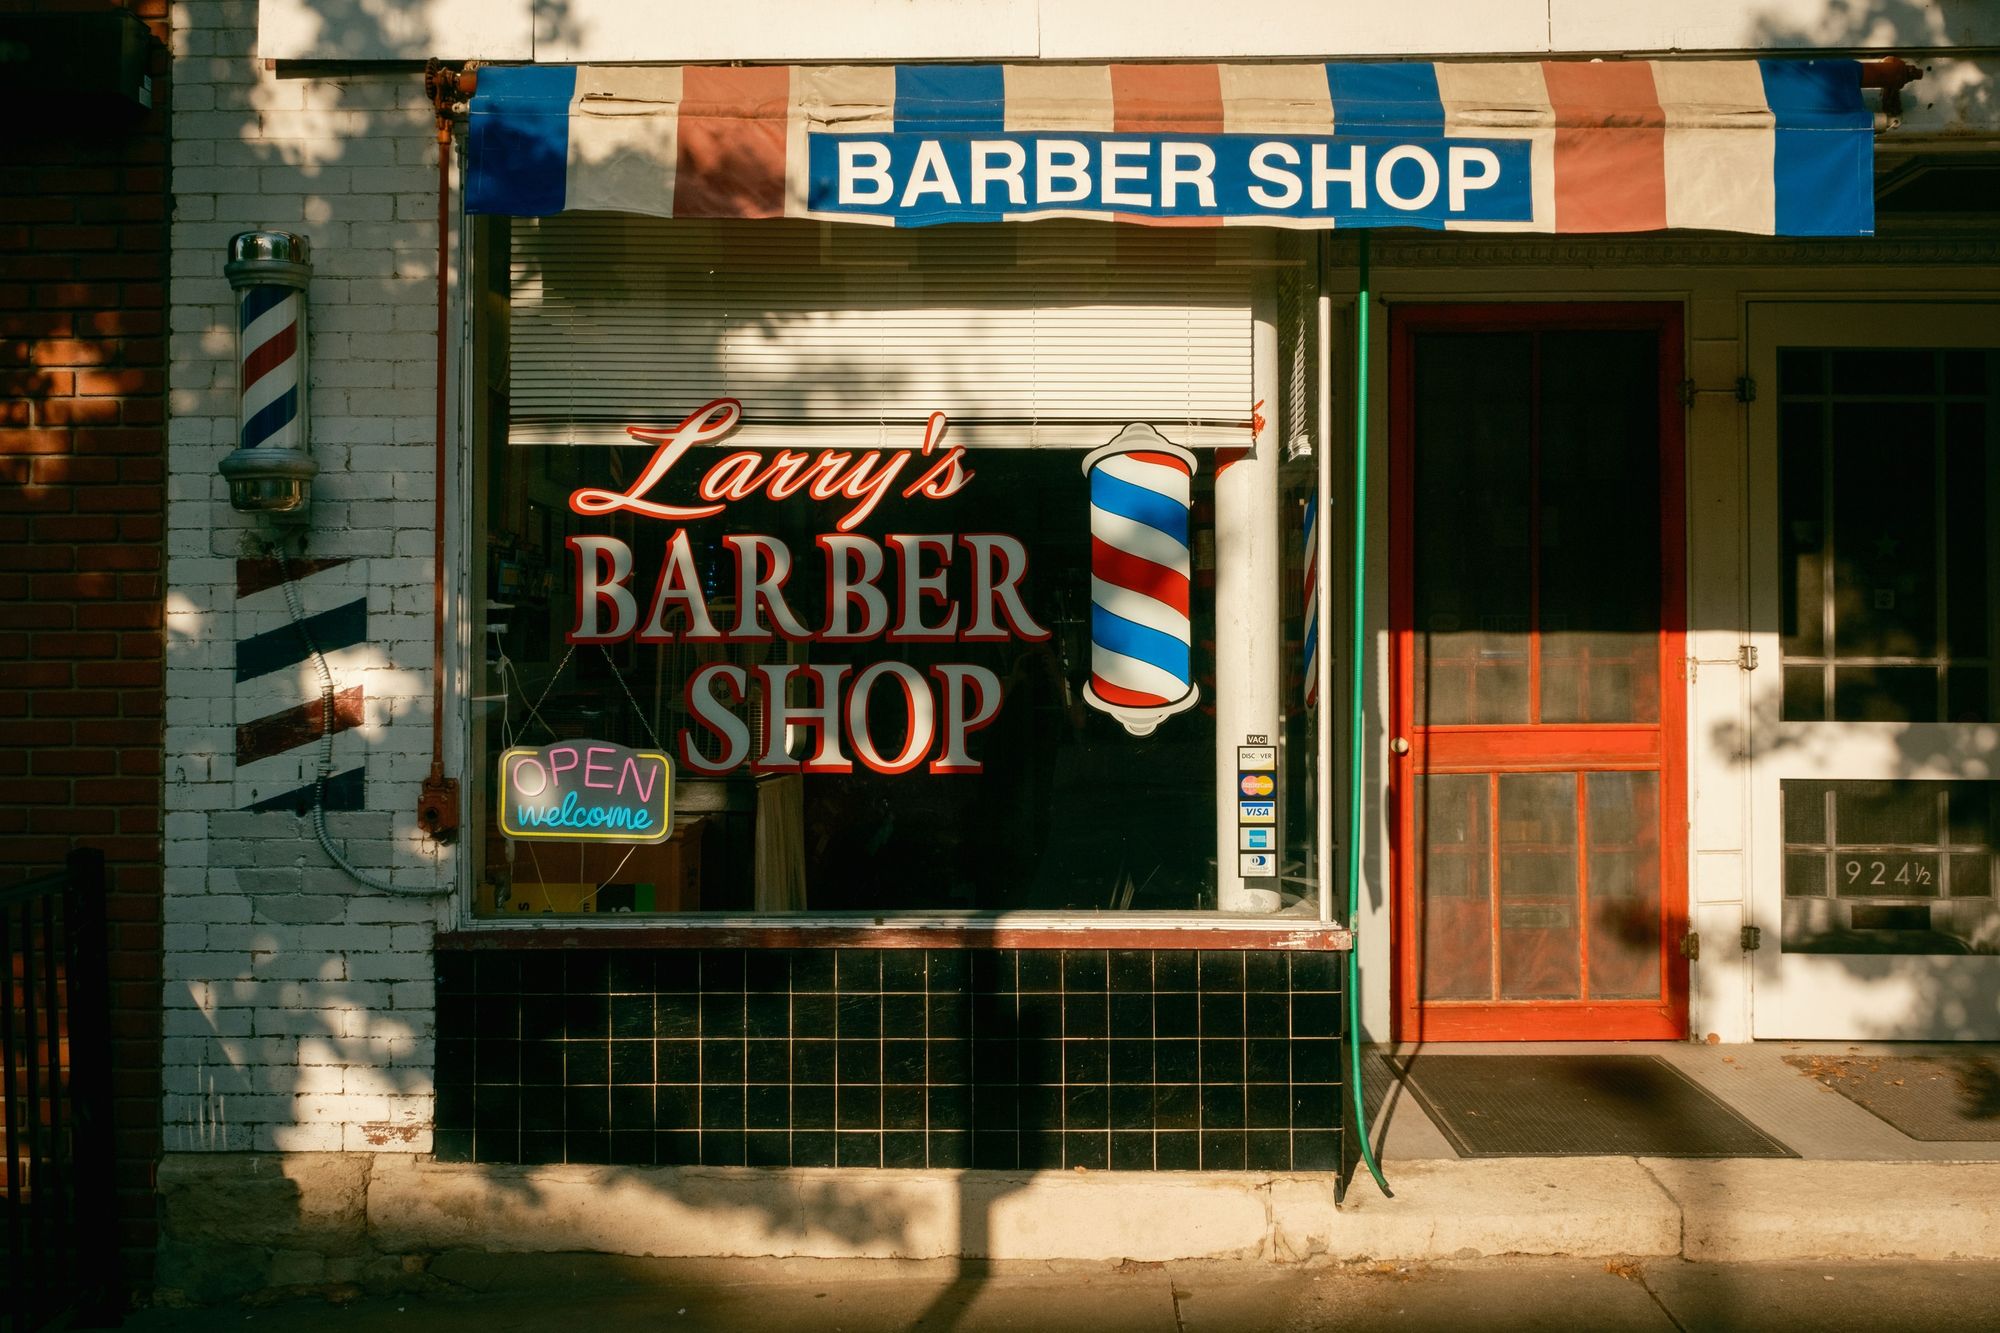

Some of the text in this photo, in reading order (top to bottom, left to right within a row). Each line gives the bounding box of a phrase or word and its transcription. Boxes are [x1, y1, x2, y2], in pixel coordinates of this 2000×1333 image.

[837, 140, 1501, 212] BARBER SHOP
[569, 397, 975, 532] Larry's
[565, 528, 1053, 645] BARBER
[678, 661, 1004, 775] SHOP
[512, 747, 658, 803] OPEN
[517, 790, 653, 830] welcome
[1246, 808, 1269, 816] VISA
